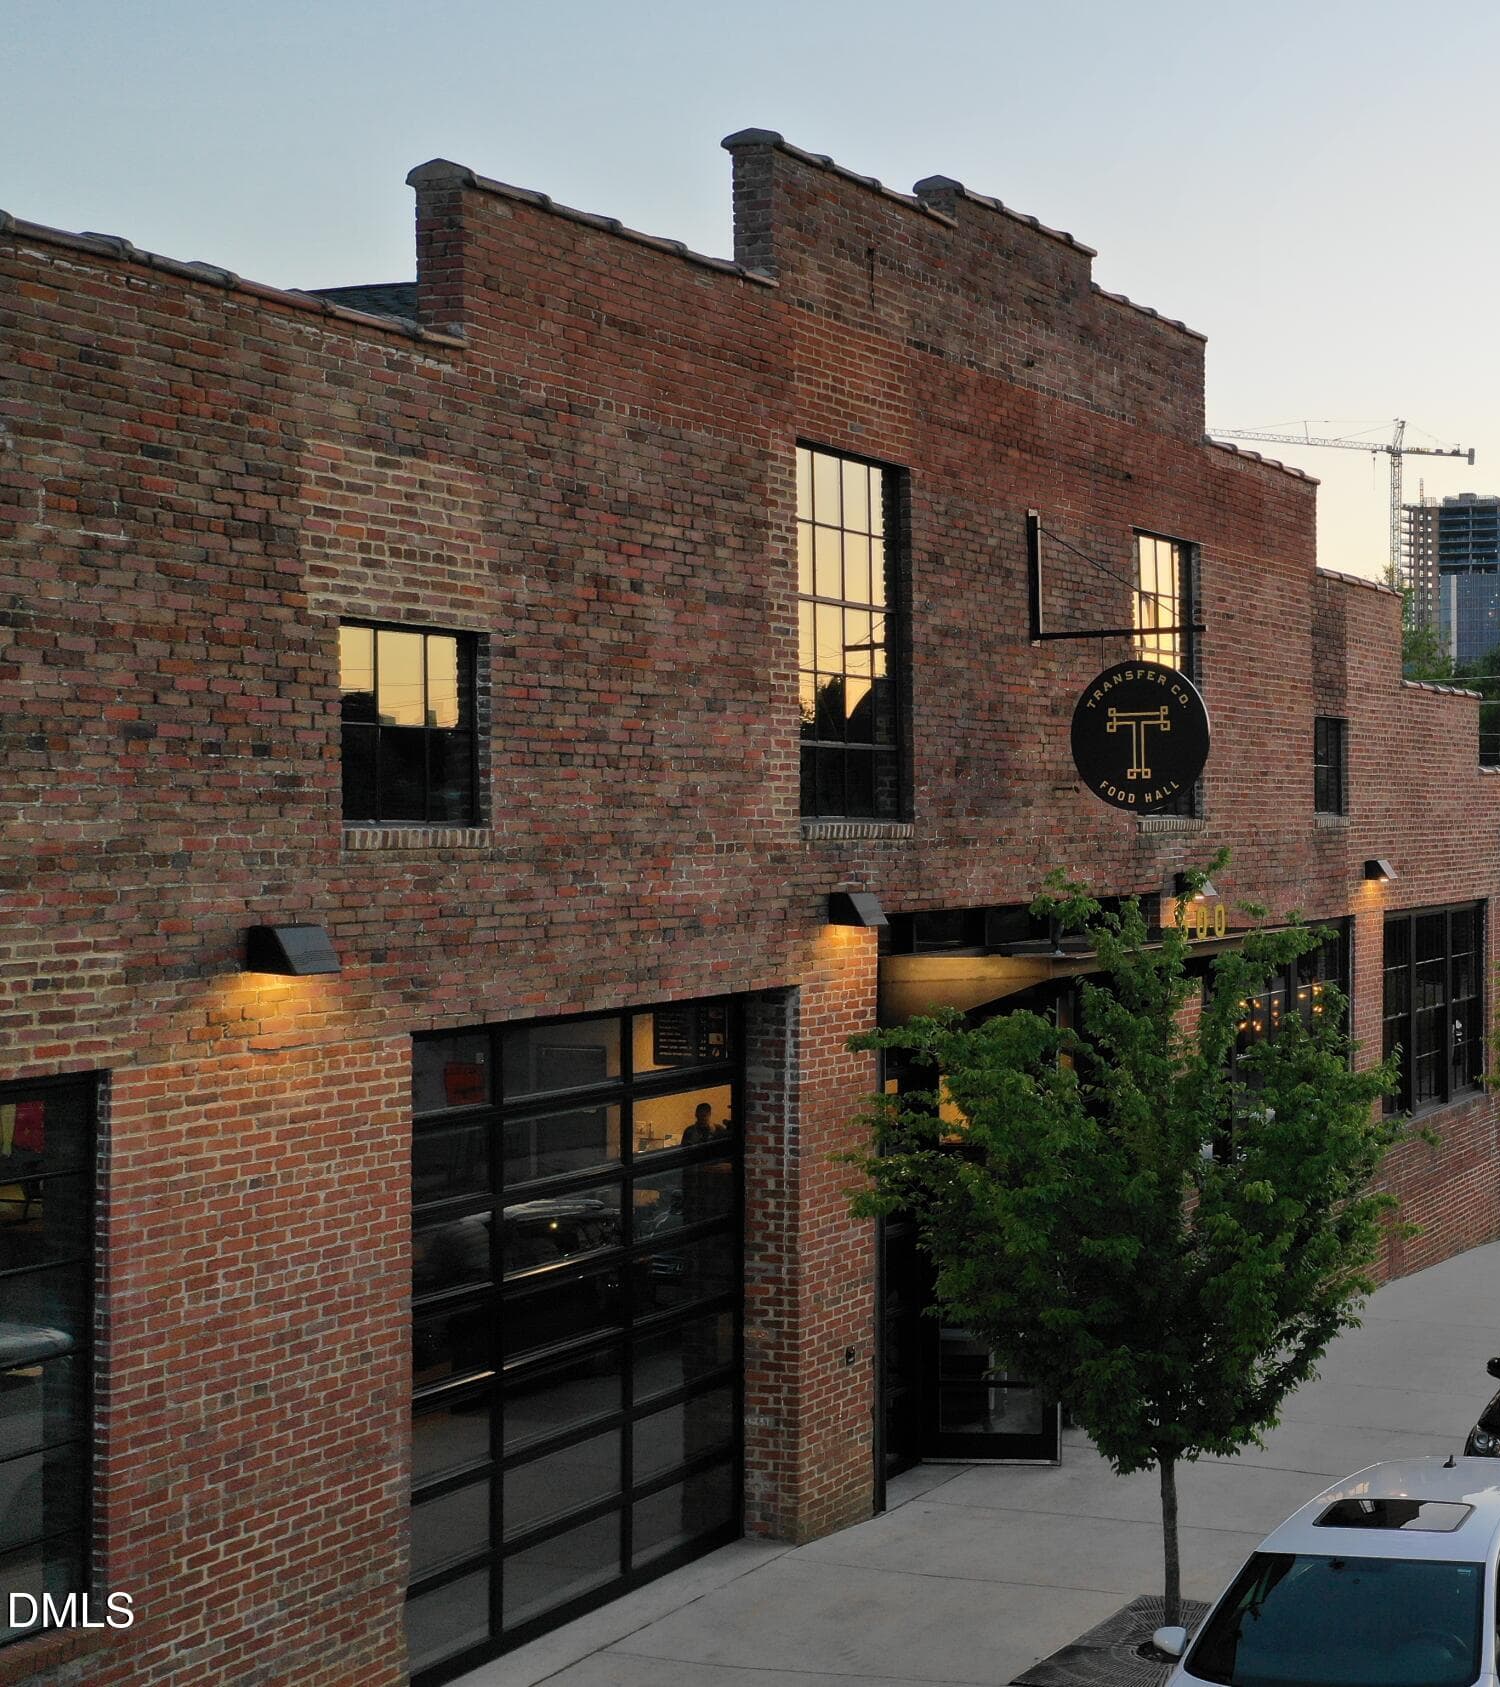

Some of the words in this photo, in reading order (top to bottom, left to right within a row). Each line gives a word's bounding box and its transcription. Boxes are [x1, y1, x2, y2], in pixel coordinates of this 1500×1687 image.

[1086, 669, 1167, 709] TRANSFER
[1171, 684, 1190, 709] CO.
[1099, 780, 1136, 804] FOOD
[1144, 780, 1180, 803] HALL
